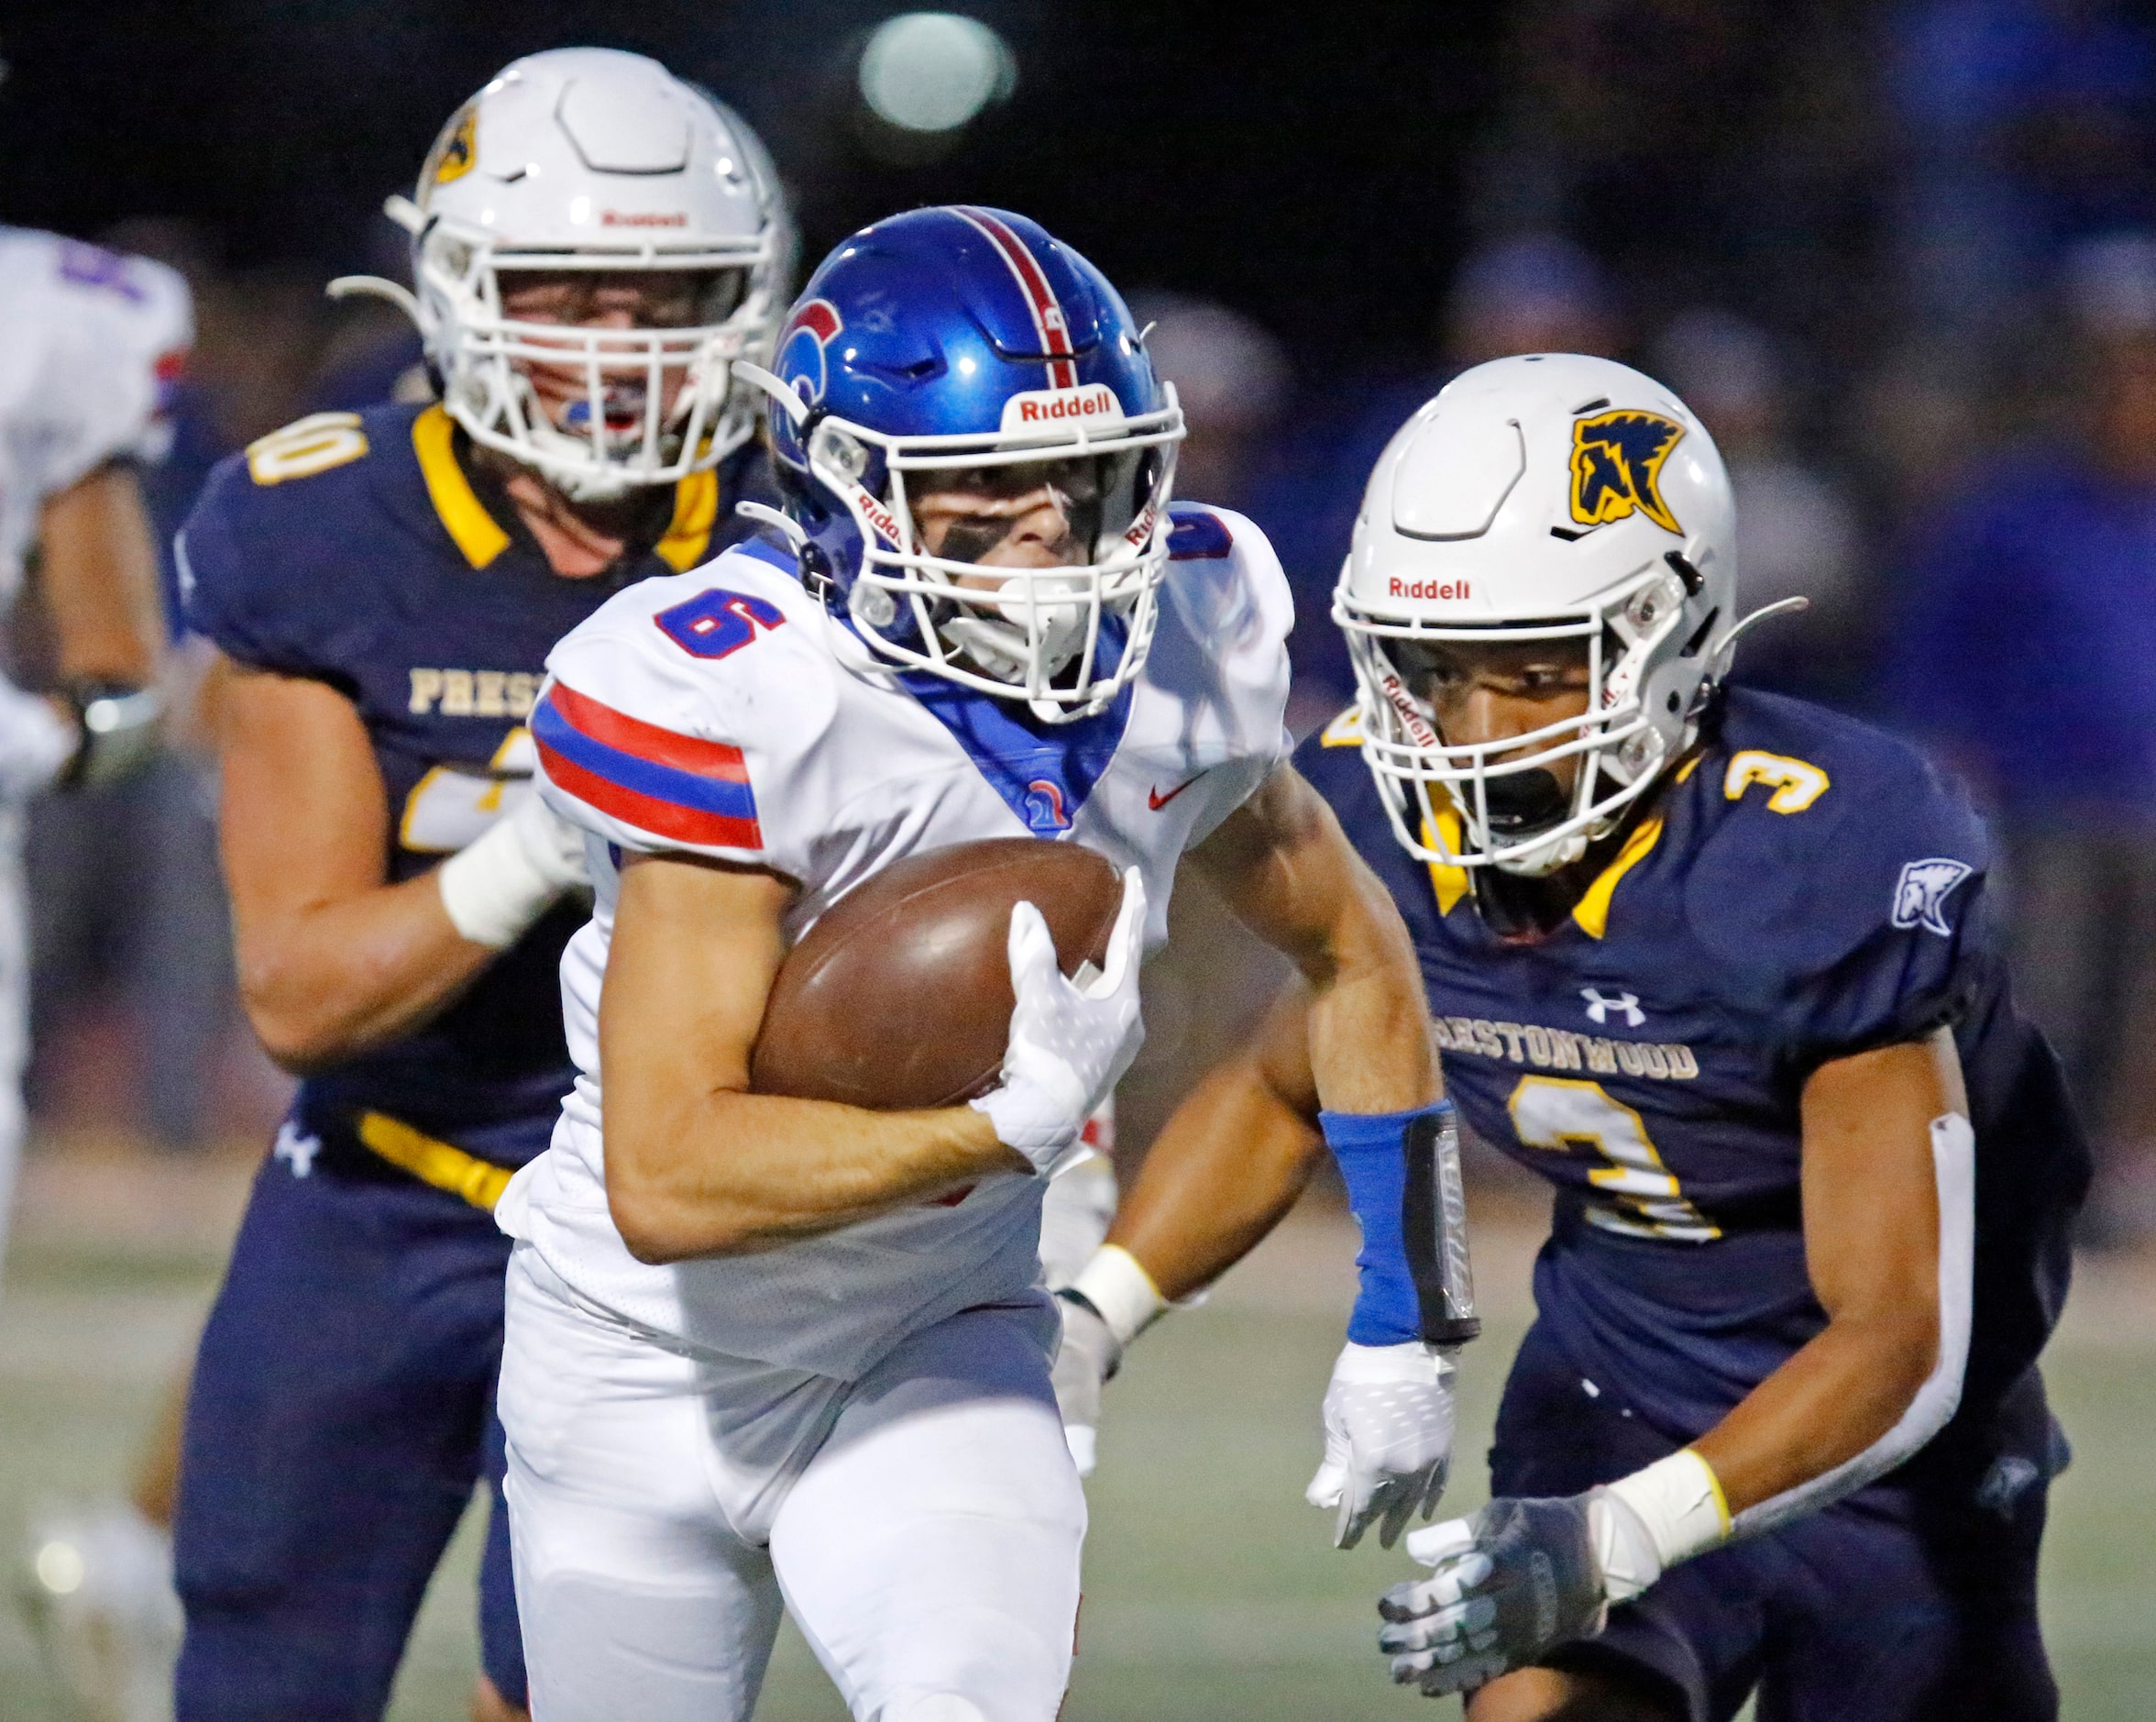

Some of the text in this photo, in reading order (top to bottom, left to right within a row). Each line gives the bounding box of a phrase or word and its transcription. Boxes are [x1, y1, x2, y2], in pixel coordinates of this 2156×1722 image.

[1020, 392, 1109, 422] Riddell
[1389, 578, 1469, 600] Riddell
[653, 588, 786, 660] 6
[410, 668, 545, 717] PRES
[1724, 749, 1830, 815] 3
[1507, 1074, 1722, 1242] 3
